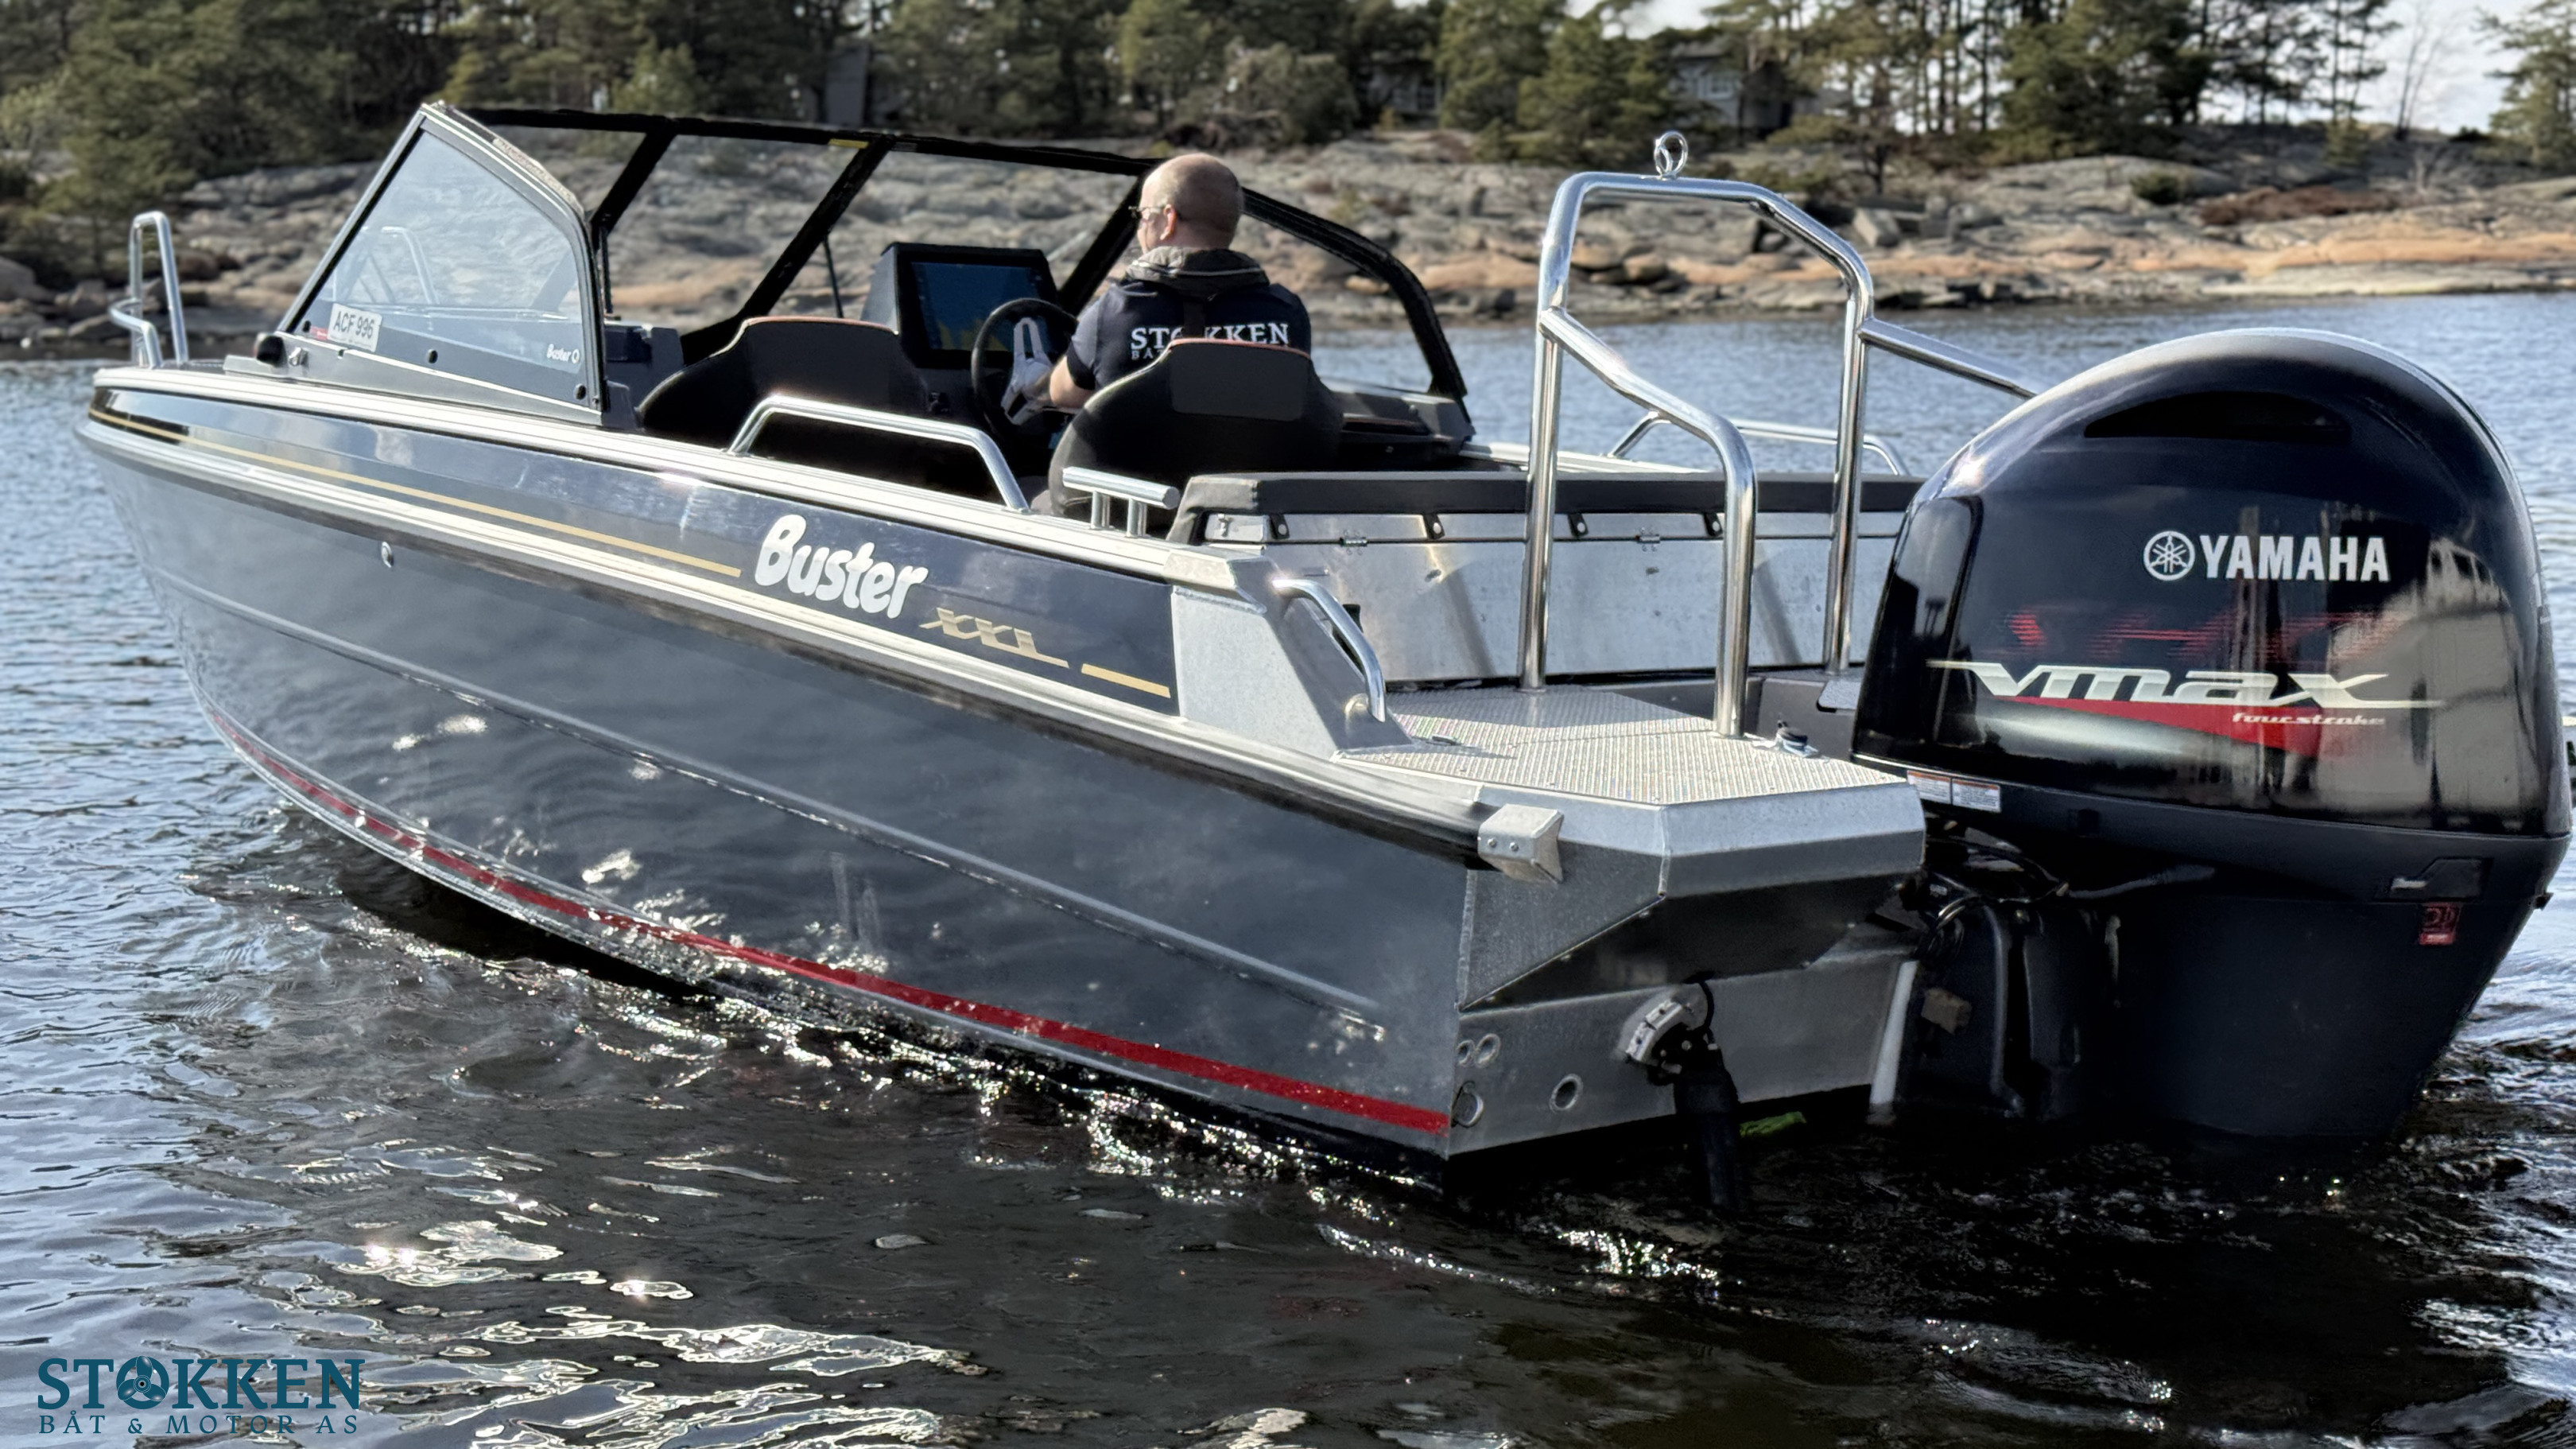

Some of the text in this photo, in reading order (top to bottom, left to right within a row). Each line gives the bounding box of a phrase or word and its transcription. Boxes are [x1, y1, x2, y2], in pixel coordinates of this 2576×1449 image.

[333, 311, 374, 340] ACF 996
[755, 515, 929, 619] Buster
[2199, 534, 2390, 581] YAMAHA
[919, 607, 1069, 669] XXL
